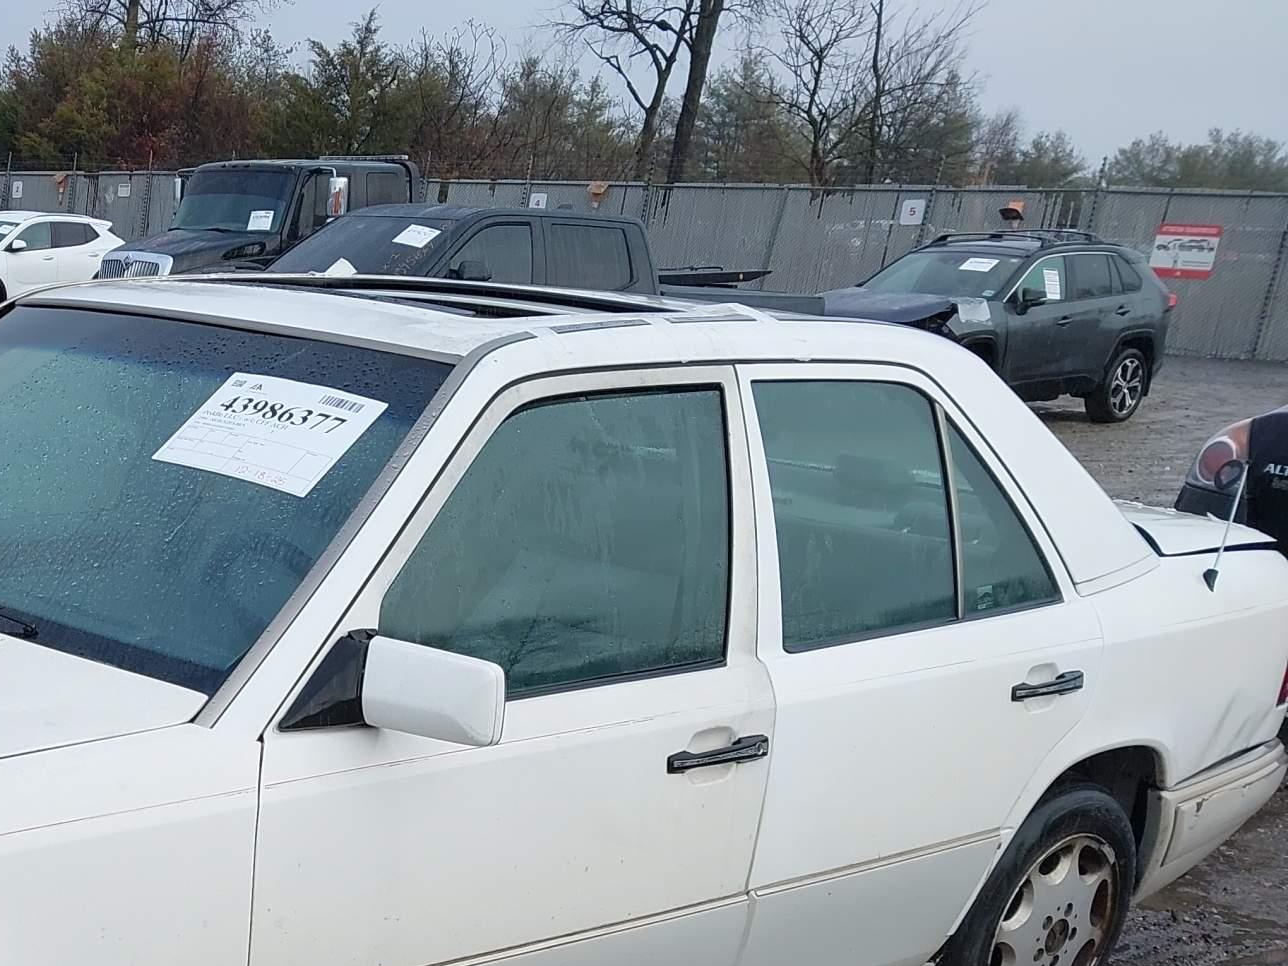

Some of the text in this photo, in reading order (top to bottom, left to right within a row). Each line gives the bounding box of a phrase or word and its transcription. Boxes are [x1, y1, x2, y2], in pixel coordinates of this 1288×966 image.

[534, 199, 541, 207] 4
[908, 206, 917, 217] 5
[220, 395, 348, 434] 43986377
